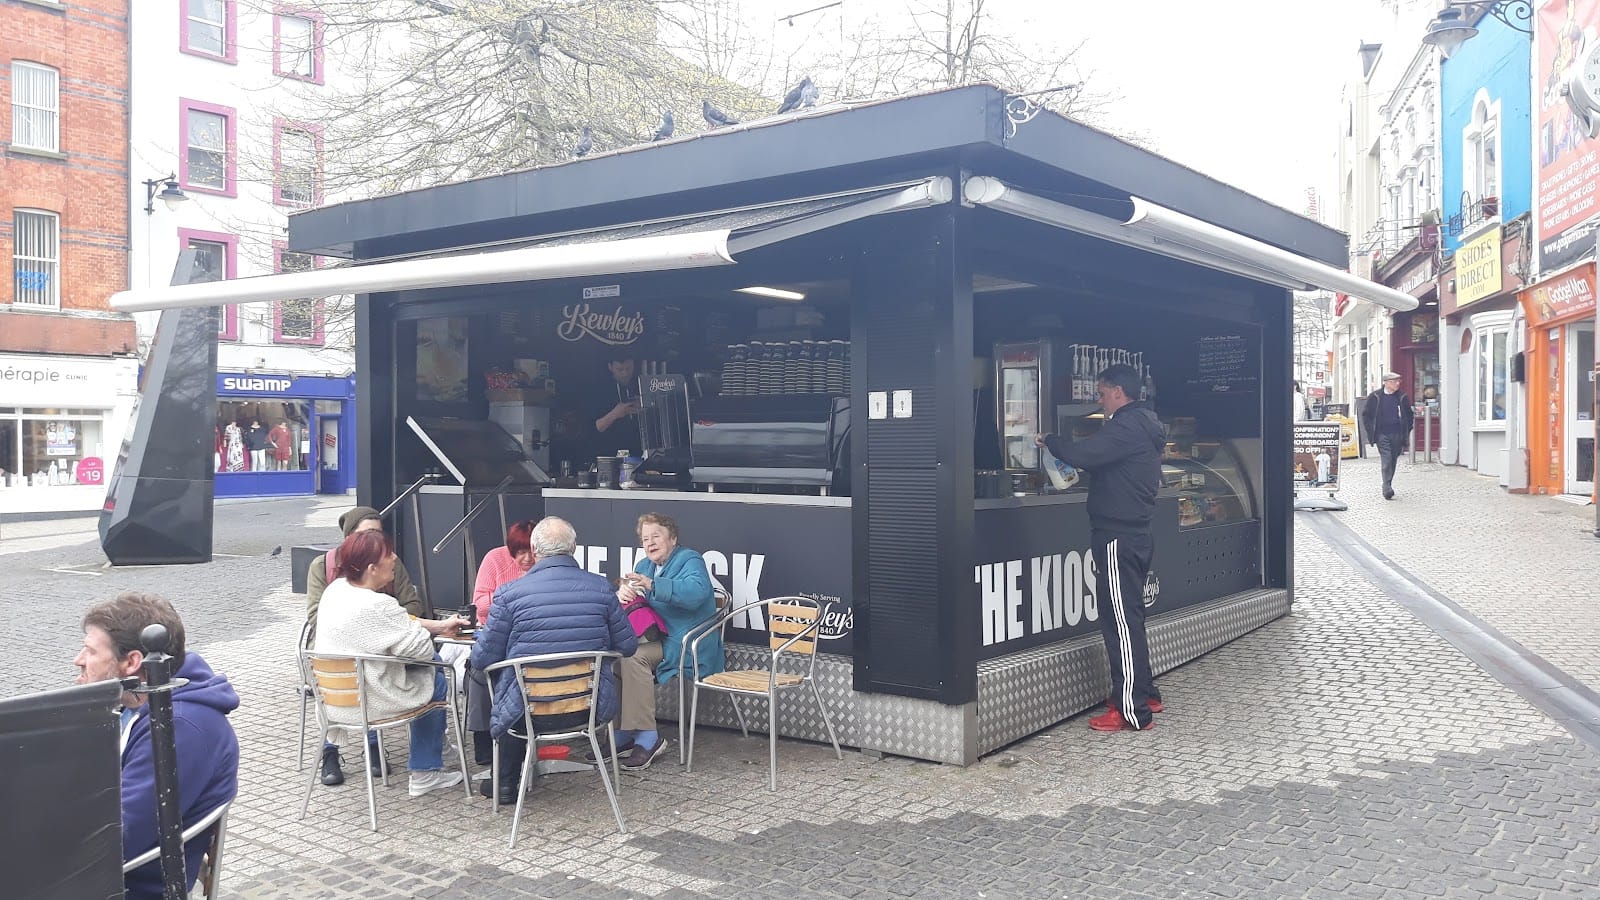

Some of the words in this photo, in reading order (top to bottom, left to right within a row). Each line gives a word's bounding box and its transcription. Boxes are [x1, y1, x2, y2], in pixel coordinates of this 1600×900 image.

[1461, 239, 1493, 269] SHOES
[1460, 260, 1496, 290] DIRECT
[557, 304, 645, 345] Bewley's
[0, 365, 60, 385] érapie
[224, 378, 292, 392] swamp
[820, 593, 841, 604] Serving
[974, 560, 1024, 646] HE
[1031, 548, 1100, 635] KIOS
[819, 626, 834, 635] 840
